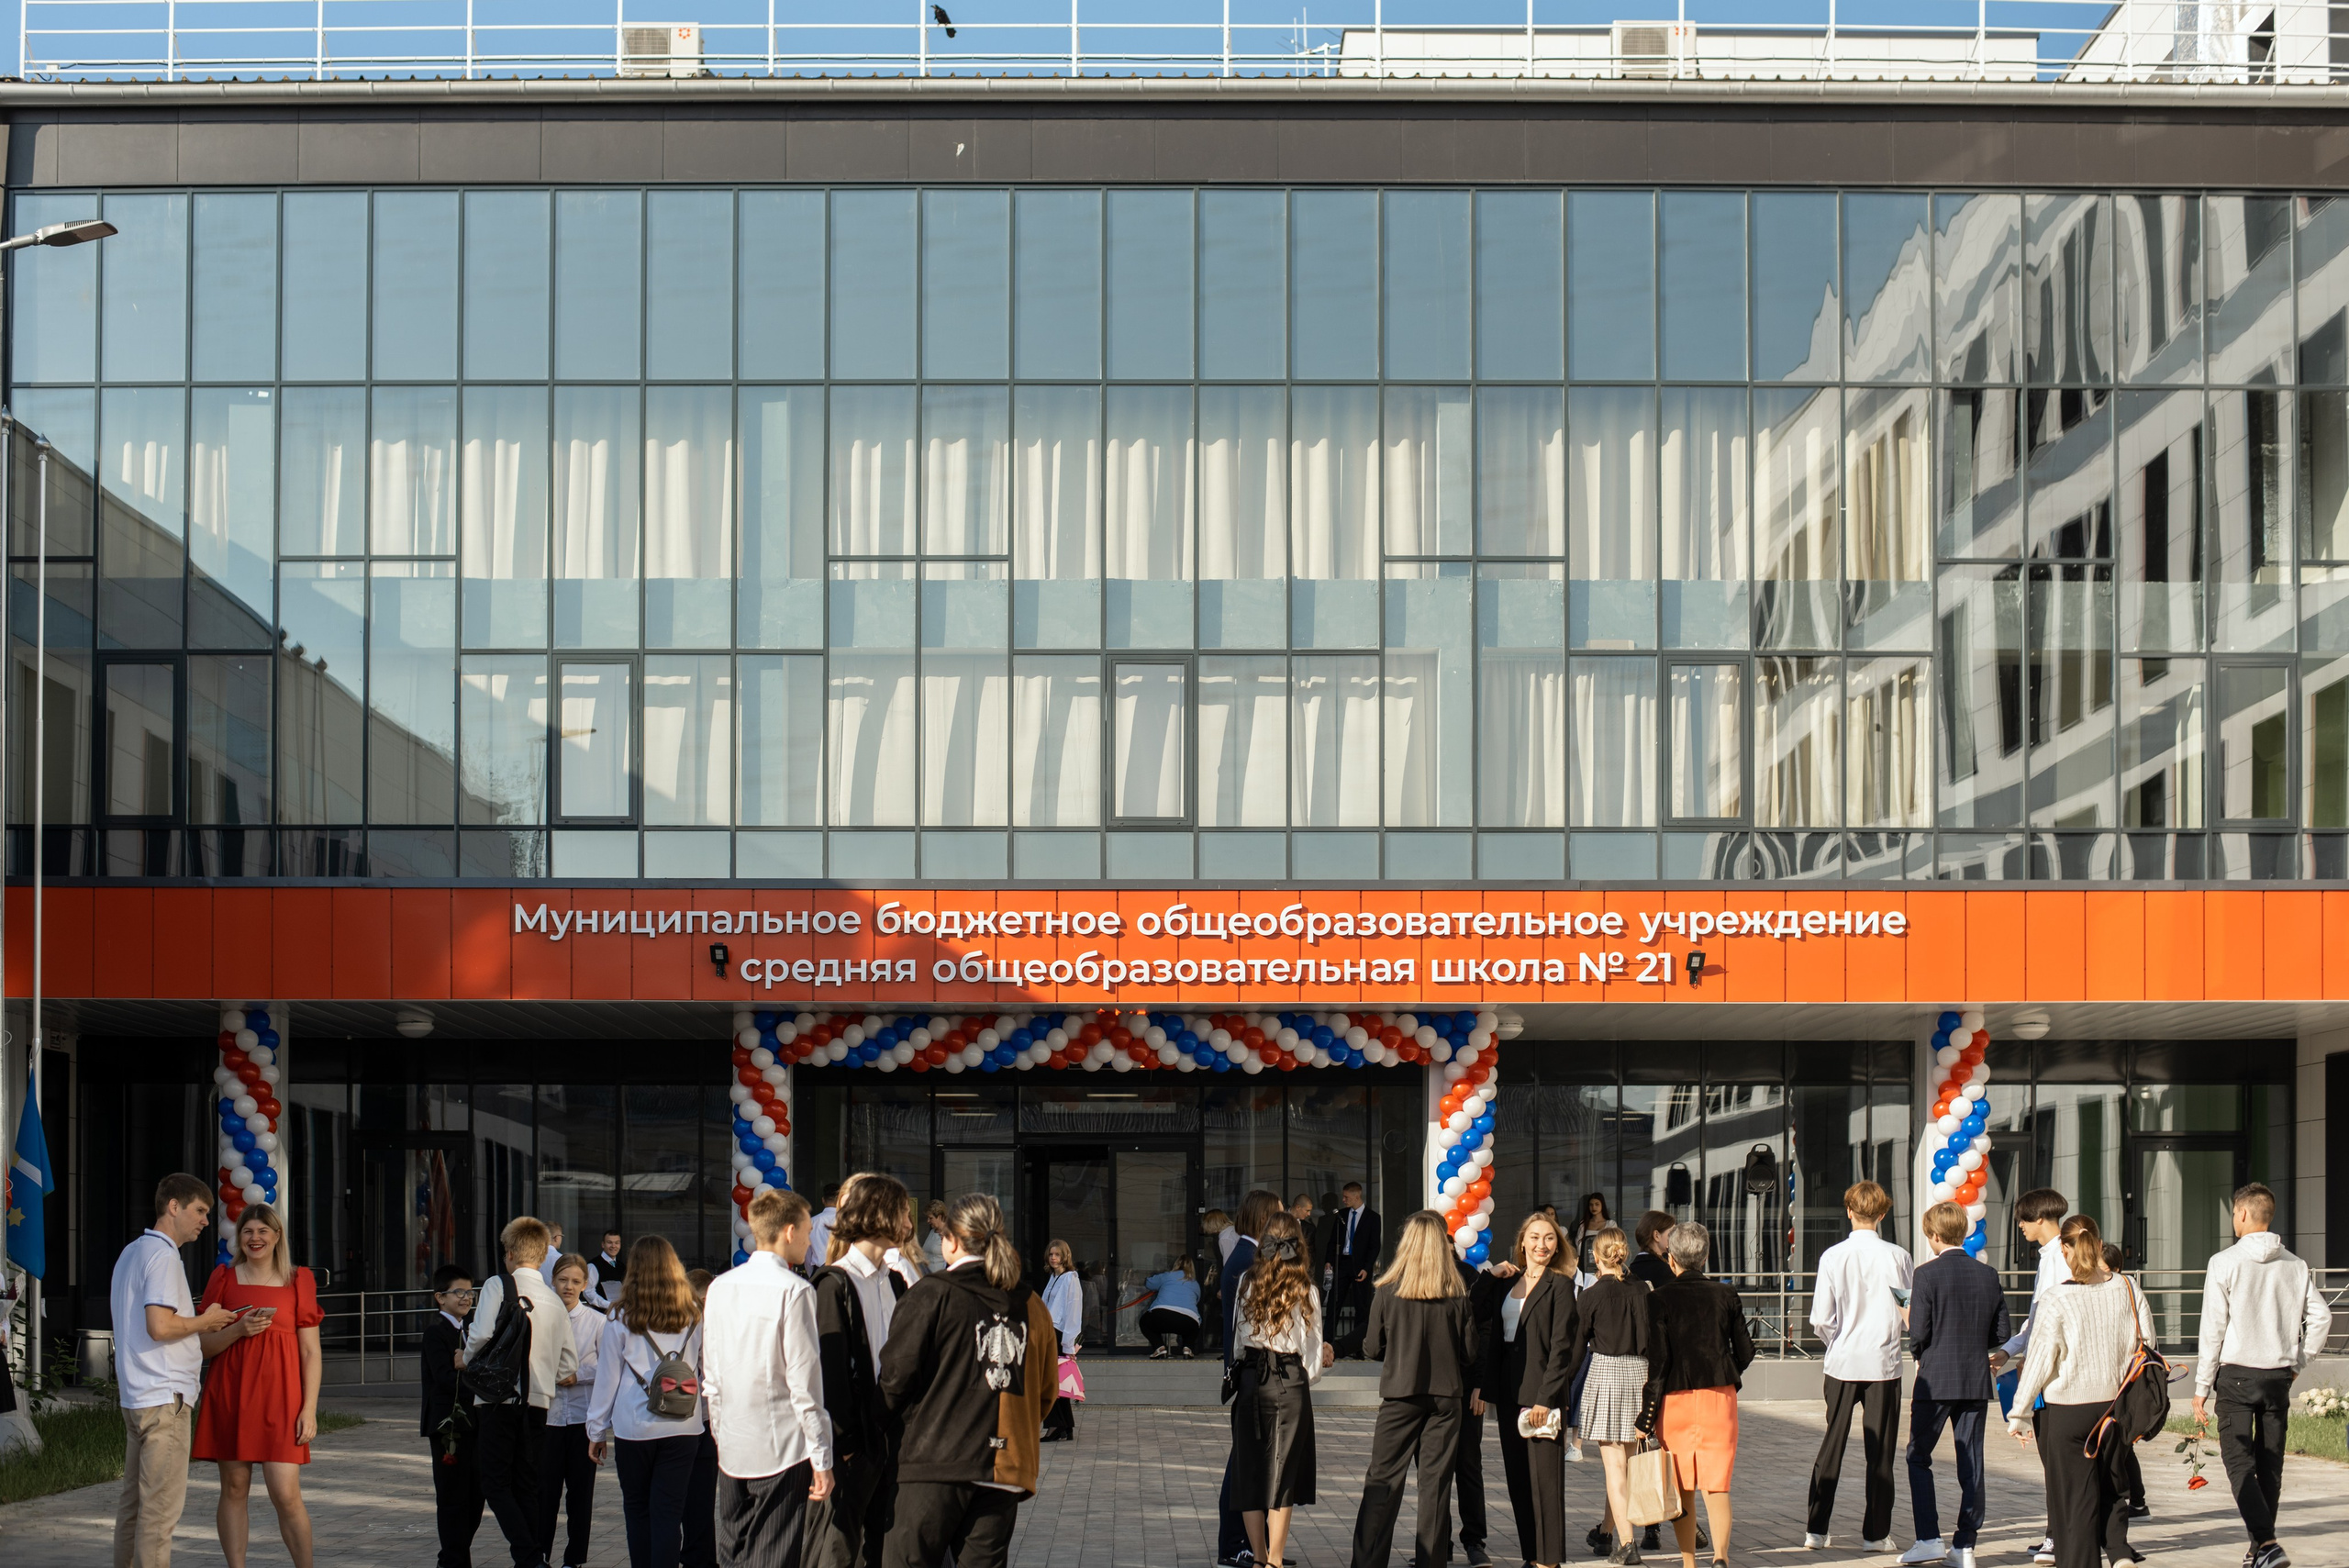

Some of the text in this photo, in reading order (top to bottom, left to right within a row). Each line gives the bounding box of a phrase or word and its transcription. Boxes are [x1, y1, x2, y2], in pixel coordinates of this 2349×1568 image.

[515, 901, 1907, 943] Муниципальное бюджетное общеобразовательное учреждение
[740, 950, 1672, 991] средняя общеобразовательная школа № 21
